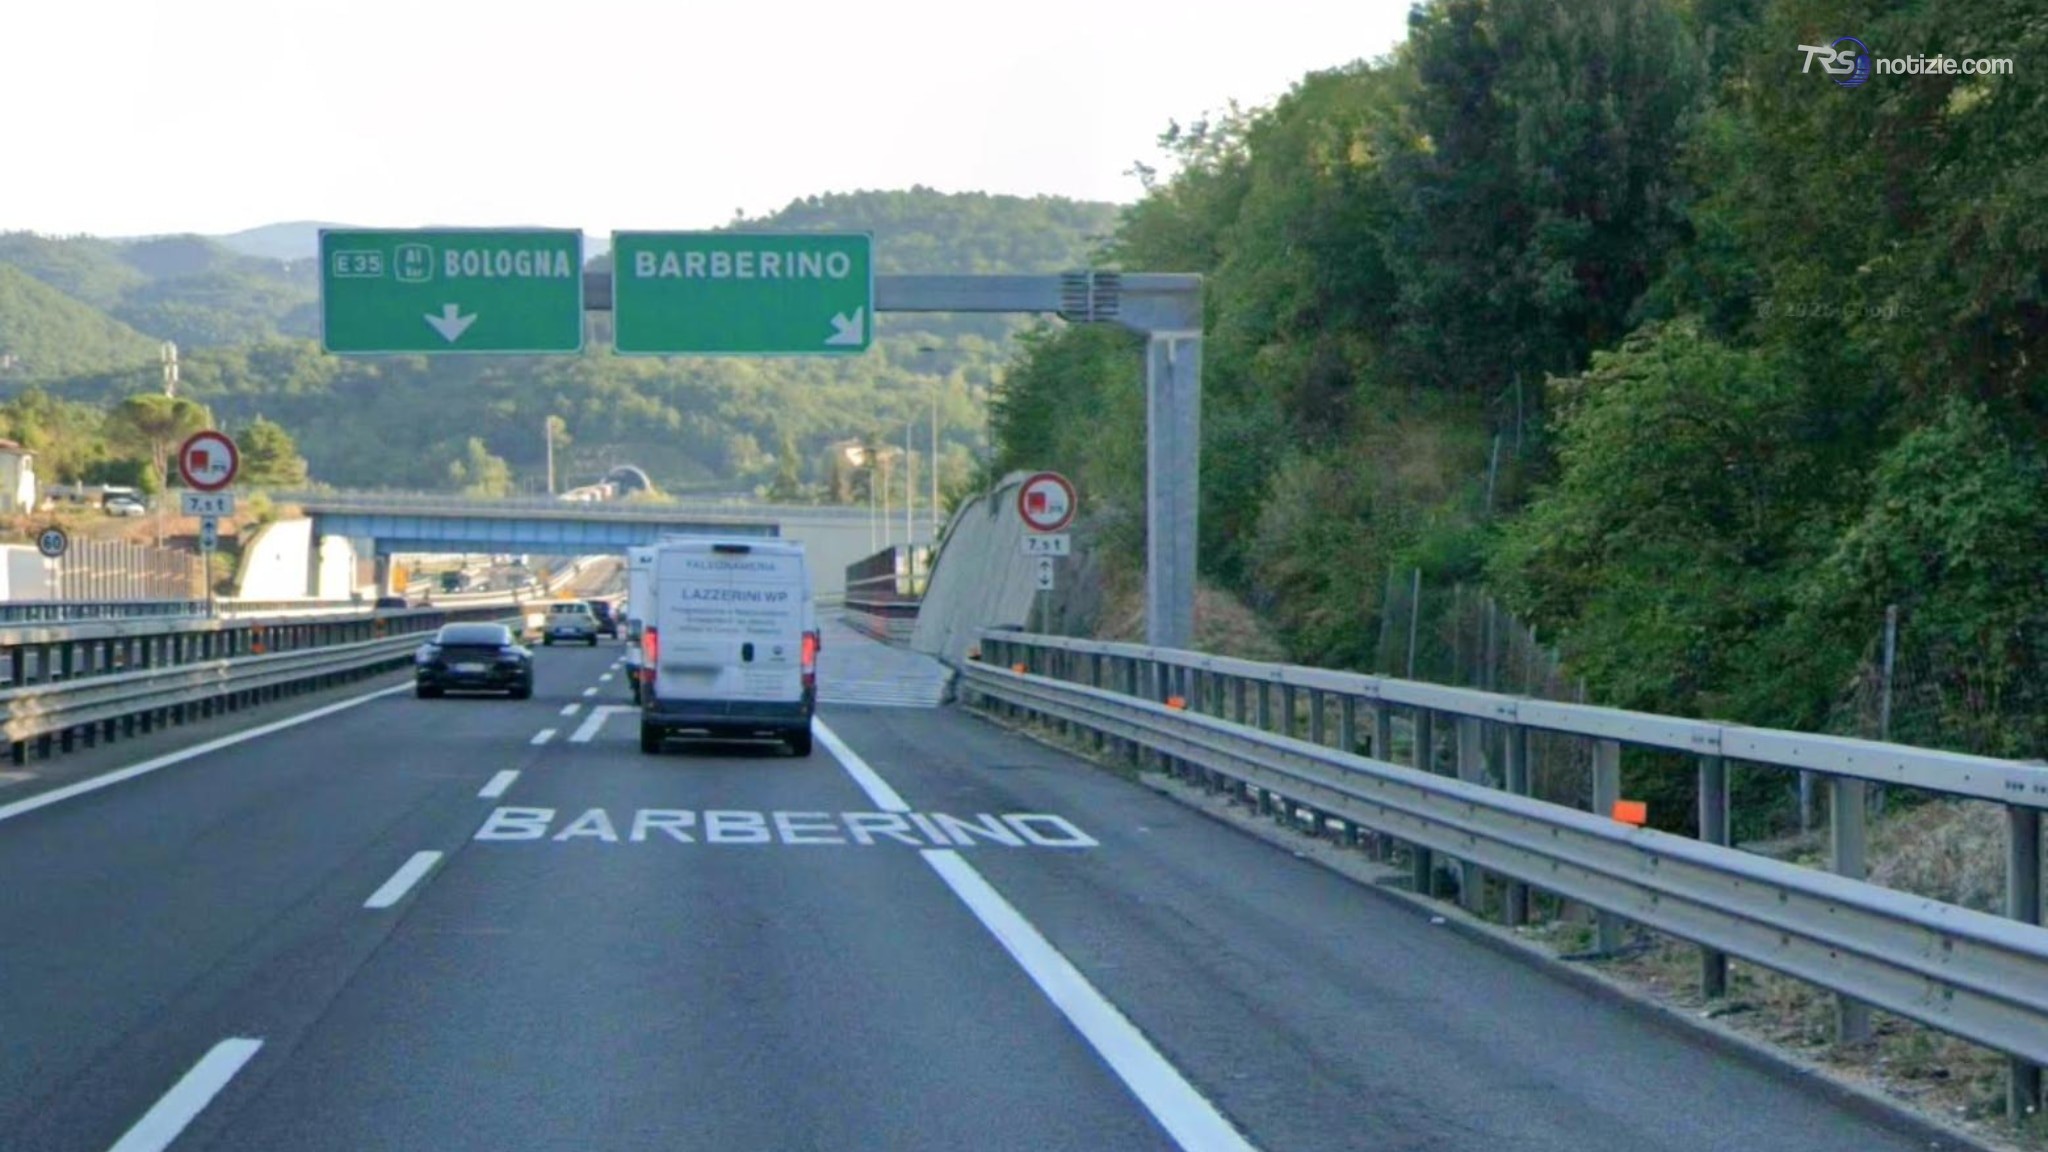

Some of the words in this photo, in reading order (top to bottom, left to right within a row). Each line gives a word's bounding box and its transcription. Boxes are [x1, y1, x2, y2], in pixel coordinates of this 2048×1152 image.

[337, 255, 349, 273] E
[354, 255, 381, 273] 35
[444, 249, 571, 278] BOLOGNA
[635, 250, 851, 280] BARBERINO
[682, 588, 761, 602] LAZZERINI
[471, 806, 1101, 848] BARBERINO
